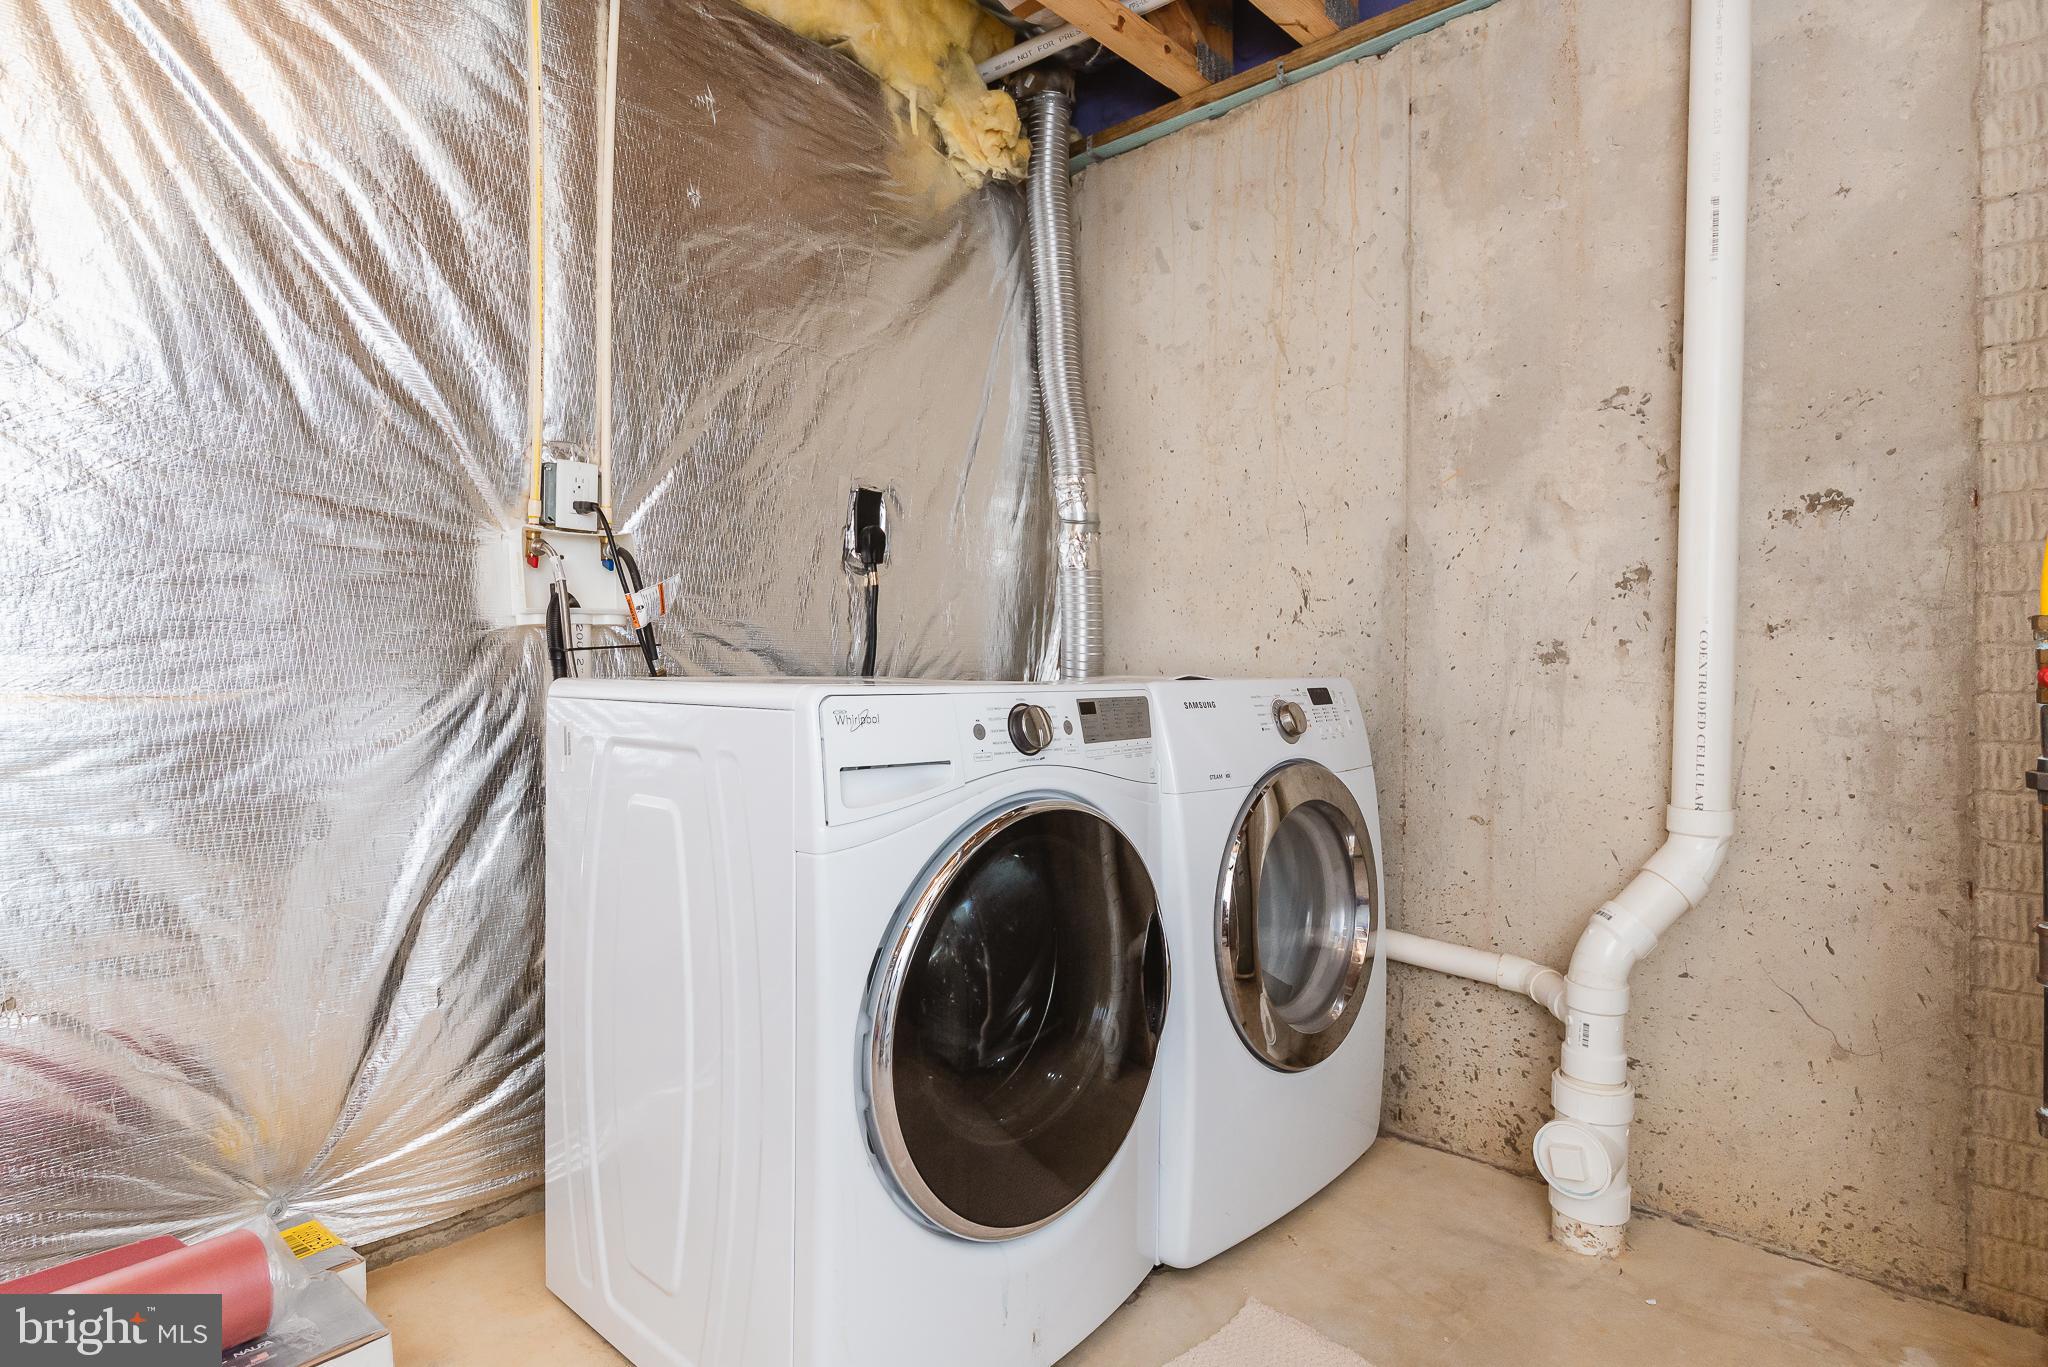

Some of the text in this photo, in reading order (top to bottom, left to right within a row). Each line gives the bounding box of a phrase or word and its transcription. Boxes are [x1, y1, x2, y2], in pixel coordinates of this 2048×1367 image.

[1016, 50, 1033, 62] NOT
[1037, 40, 1055, 53] FOR
[1183, 701, 1216, 709] SAMSUNG
[833, 712, 880, 728] Whirlpool
[1694, 630, 1709, 812] COEXTRUDED CELLULAR
